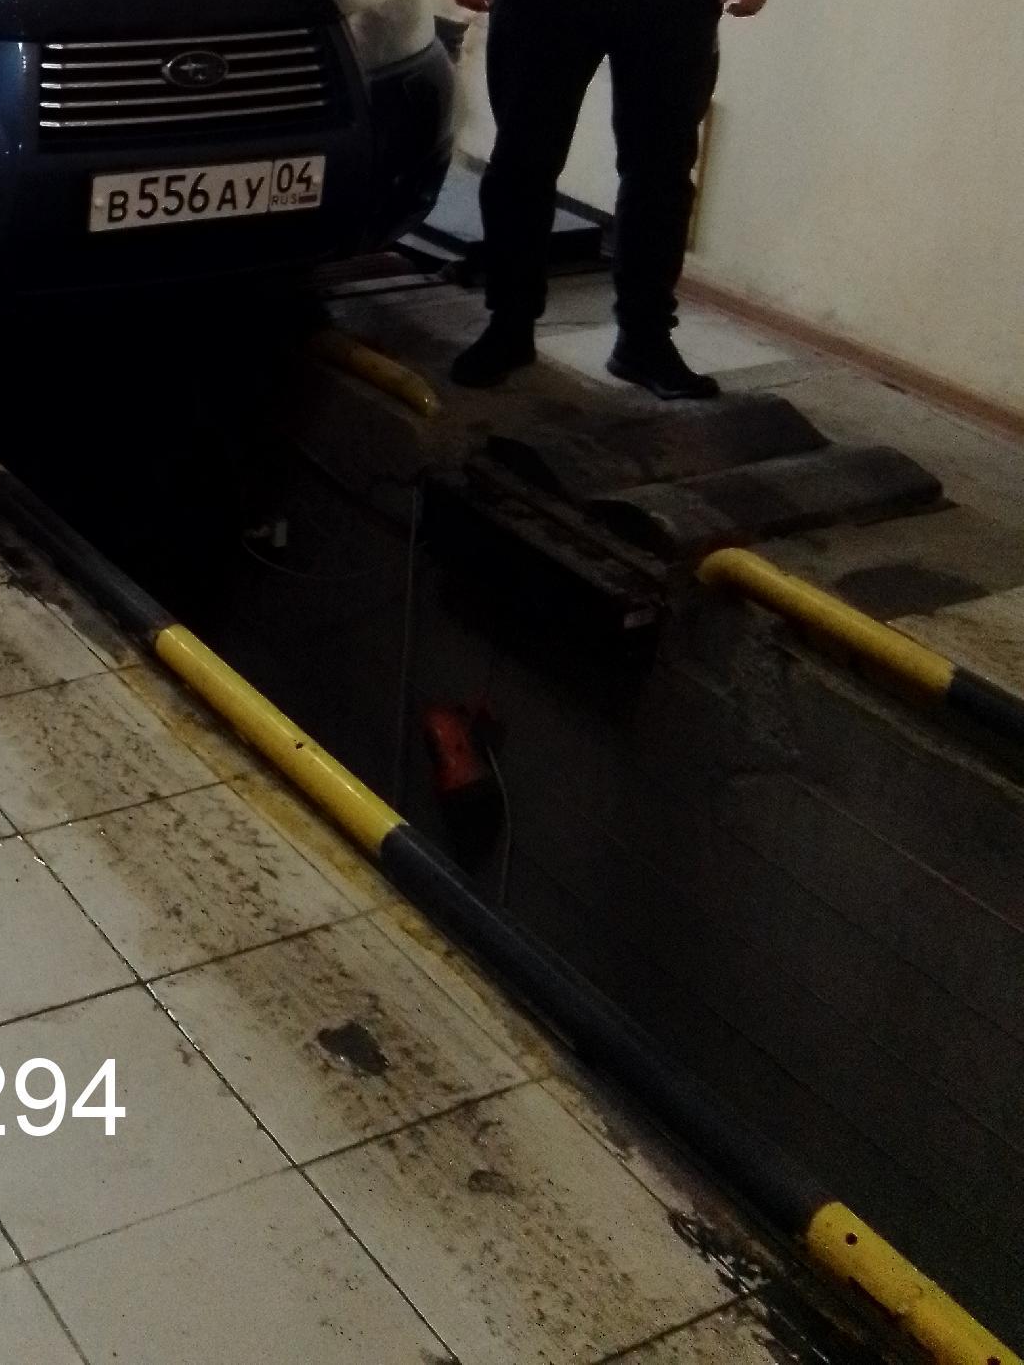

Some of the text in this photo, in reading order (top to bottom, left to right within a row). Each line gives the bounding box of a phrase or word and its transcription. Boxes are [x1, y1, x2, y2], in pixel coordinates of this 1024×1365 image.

[107, 161, 313, 223] В556АУ 04
[271, 193, 298, 206] RUS
